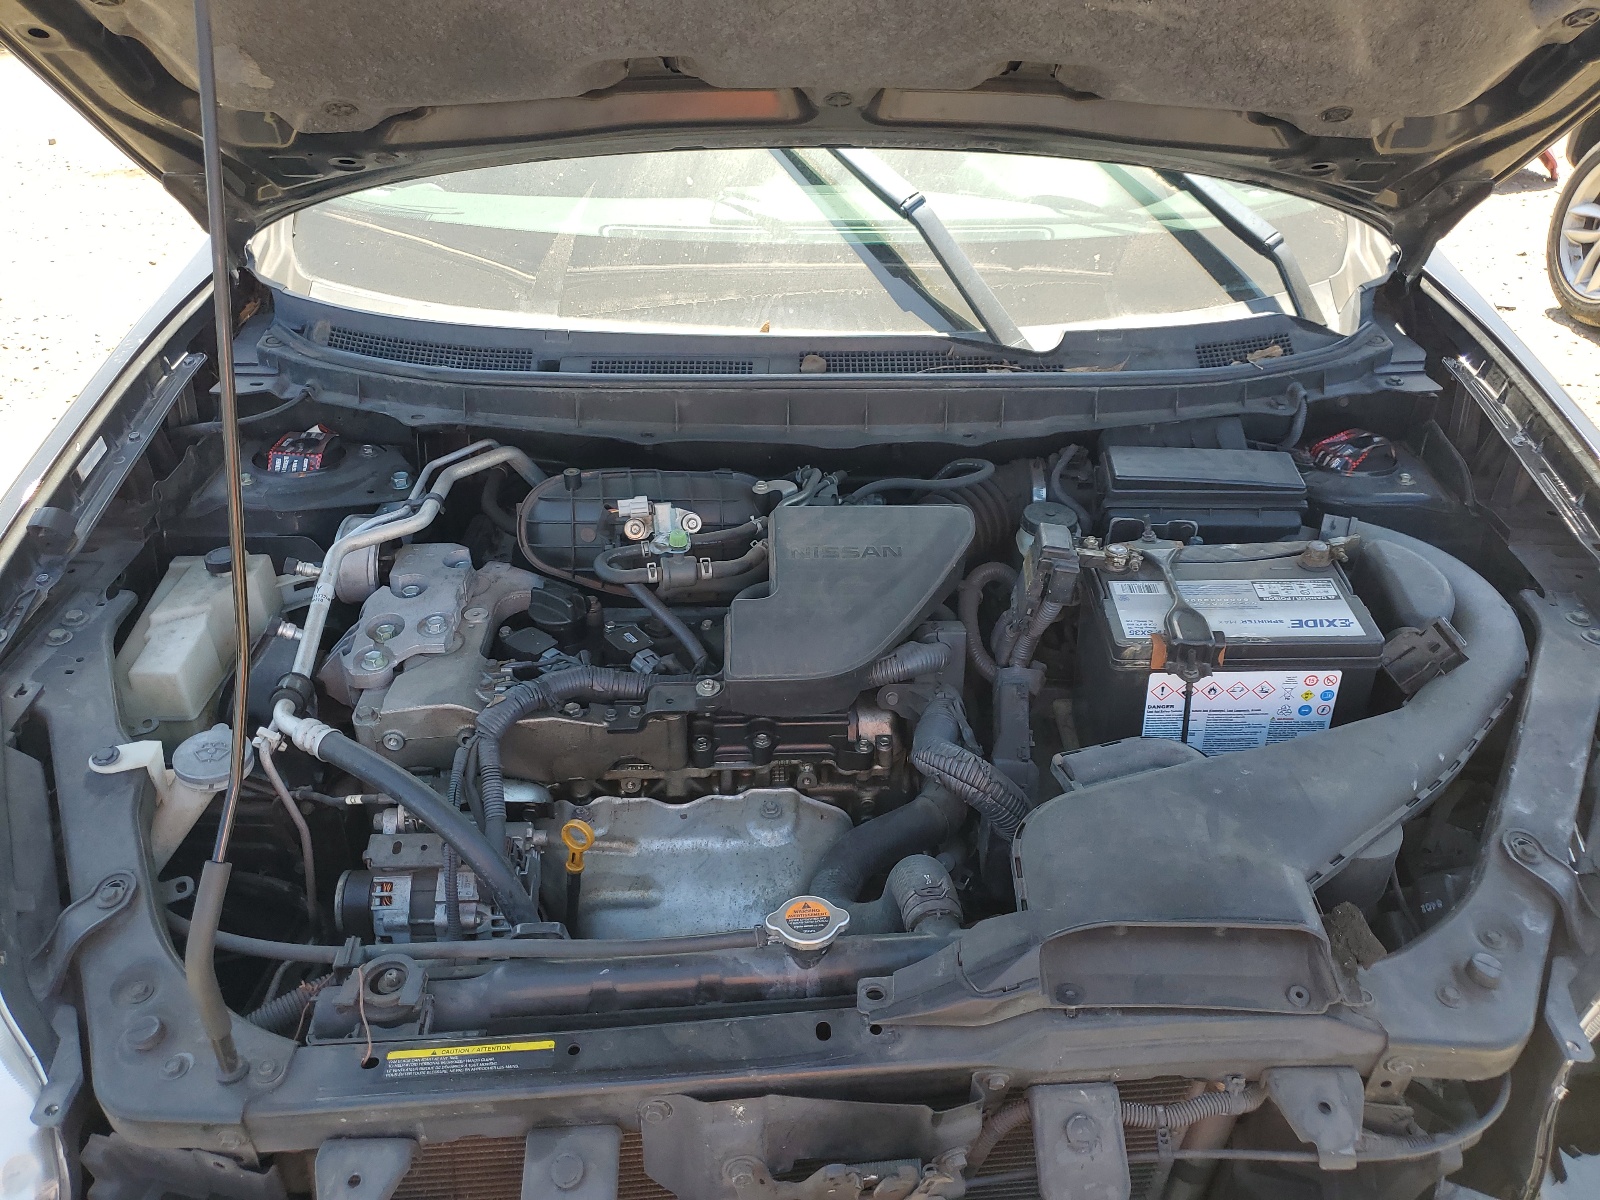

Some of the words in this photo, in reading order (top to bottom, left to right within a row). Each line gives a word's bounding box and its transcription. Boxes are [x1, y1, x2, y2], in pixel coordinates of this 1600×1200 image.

[789, 545, 903, 559] NISSAN
[1291, 618, 1354, 629] EXIDE
[441, 1047, 470, 1055] CAUTION
